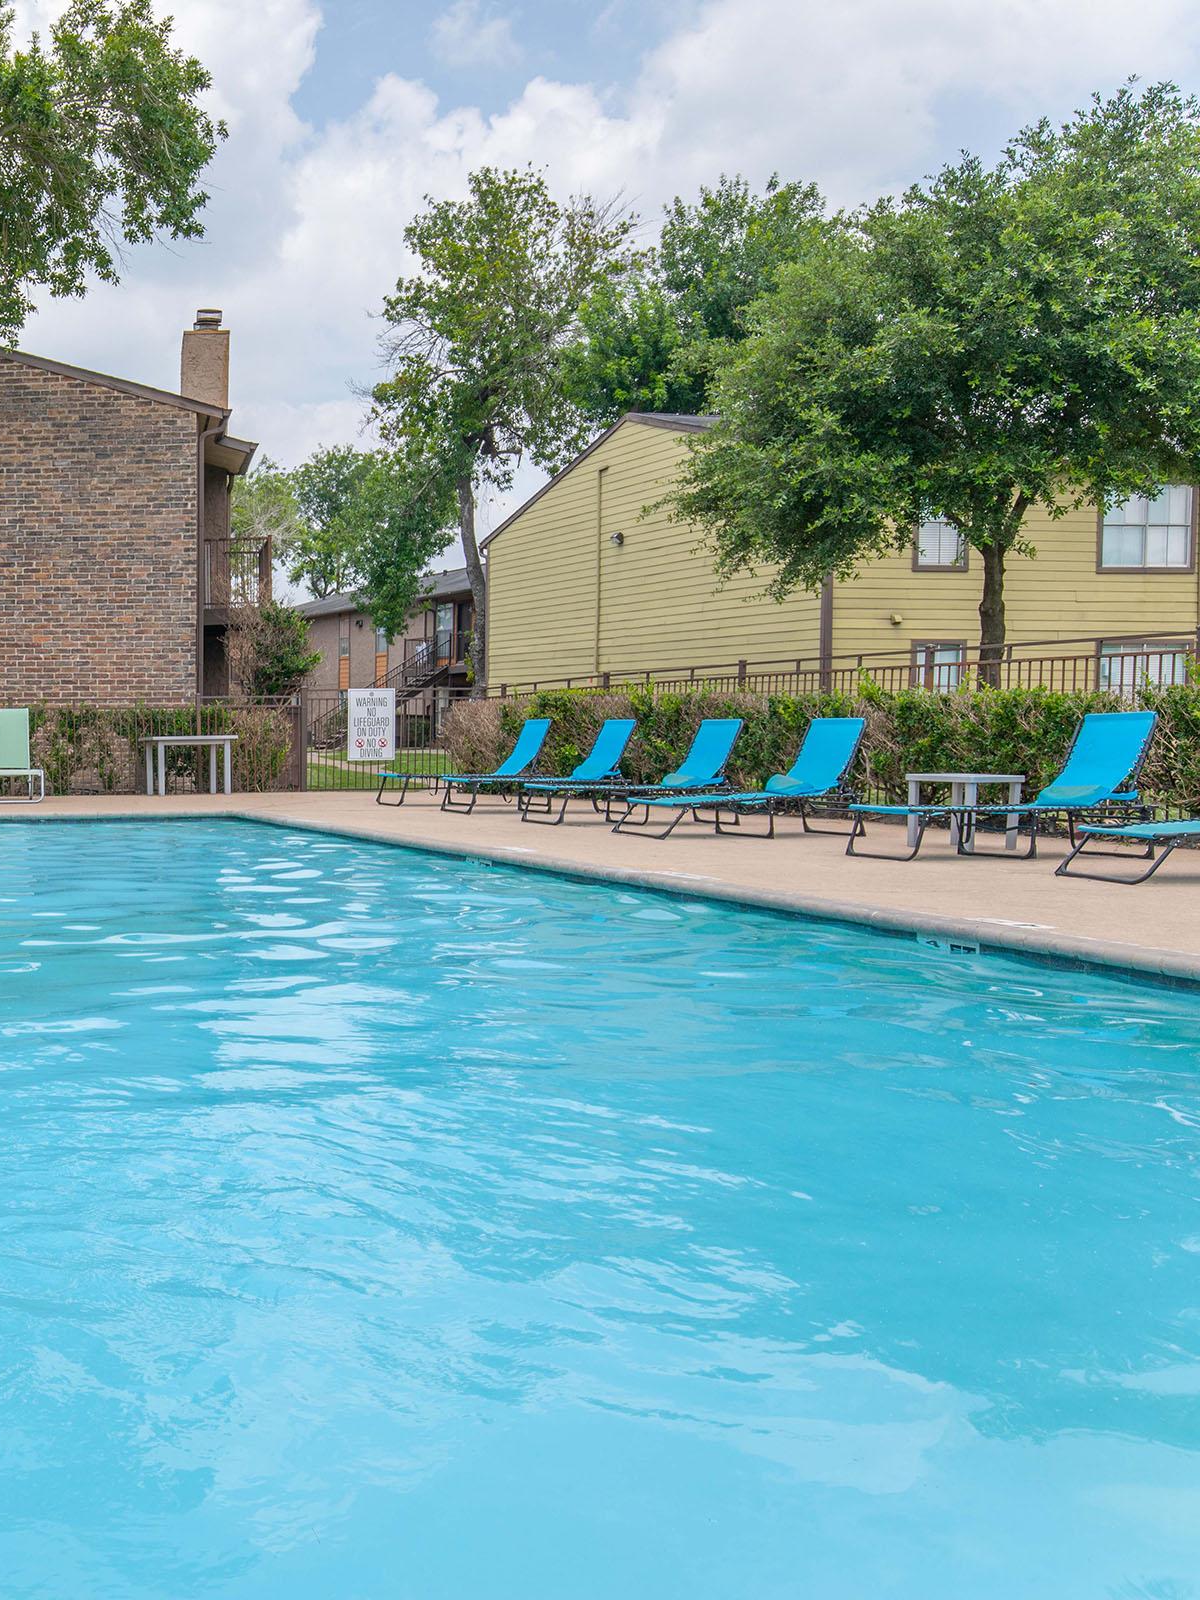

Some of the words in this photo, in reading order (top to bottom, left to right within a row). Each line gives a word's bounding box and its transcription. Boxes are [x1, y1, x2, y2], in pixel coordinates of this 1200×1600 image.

[356, 697, 387, 707] WARNING
[367, 708, 376, 717] NO
[354, 717, 389, 727] LIFEGUARD
[357, 727, 366, 737] ON
[368, 727, 386, 737] DUTY
[366, 738, 376, 747] NO
[360, 748, 383, 758] DIVING
